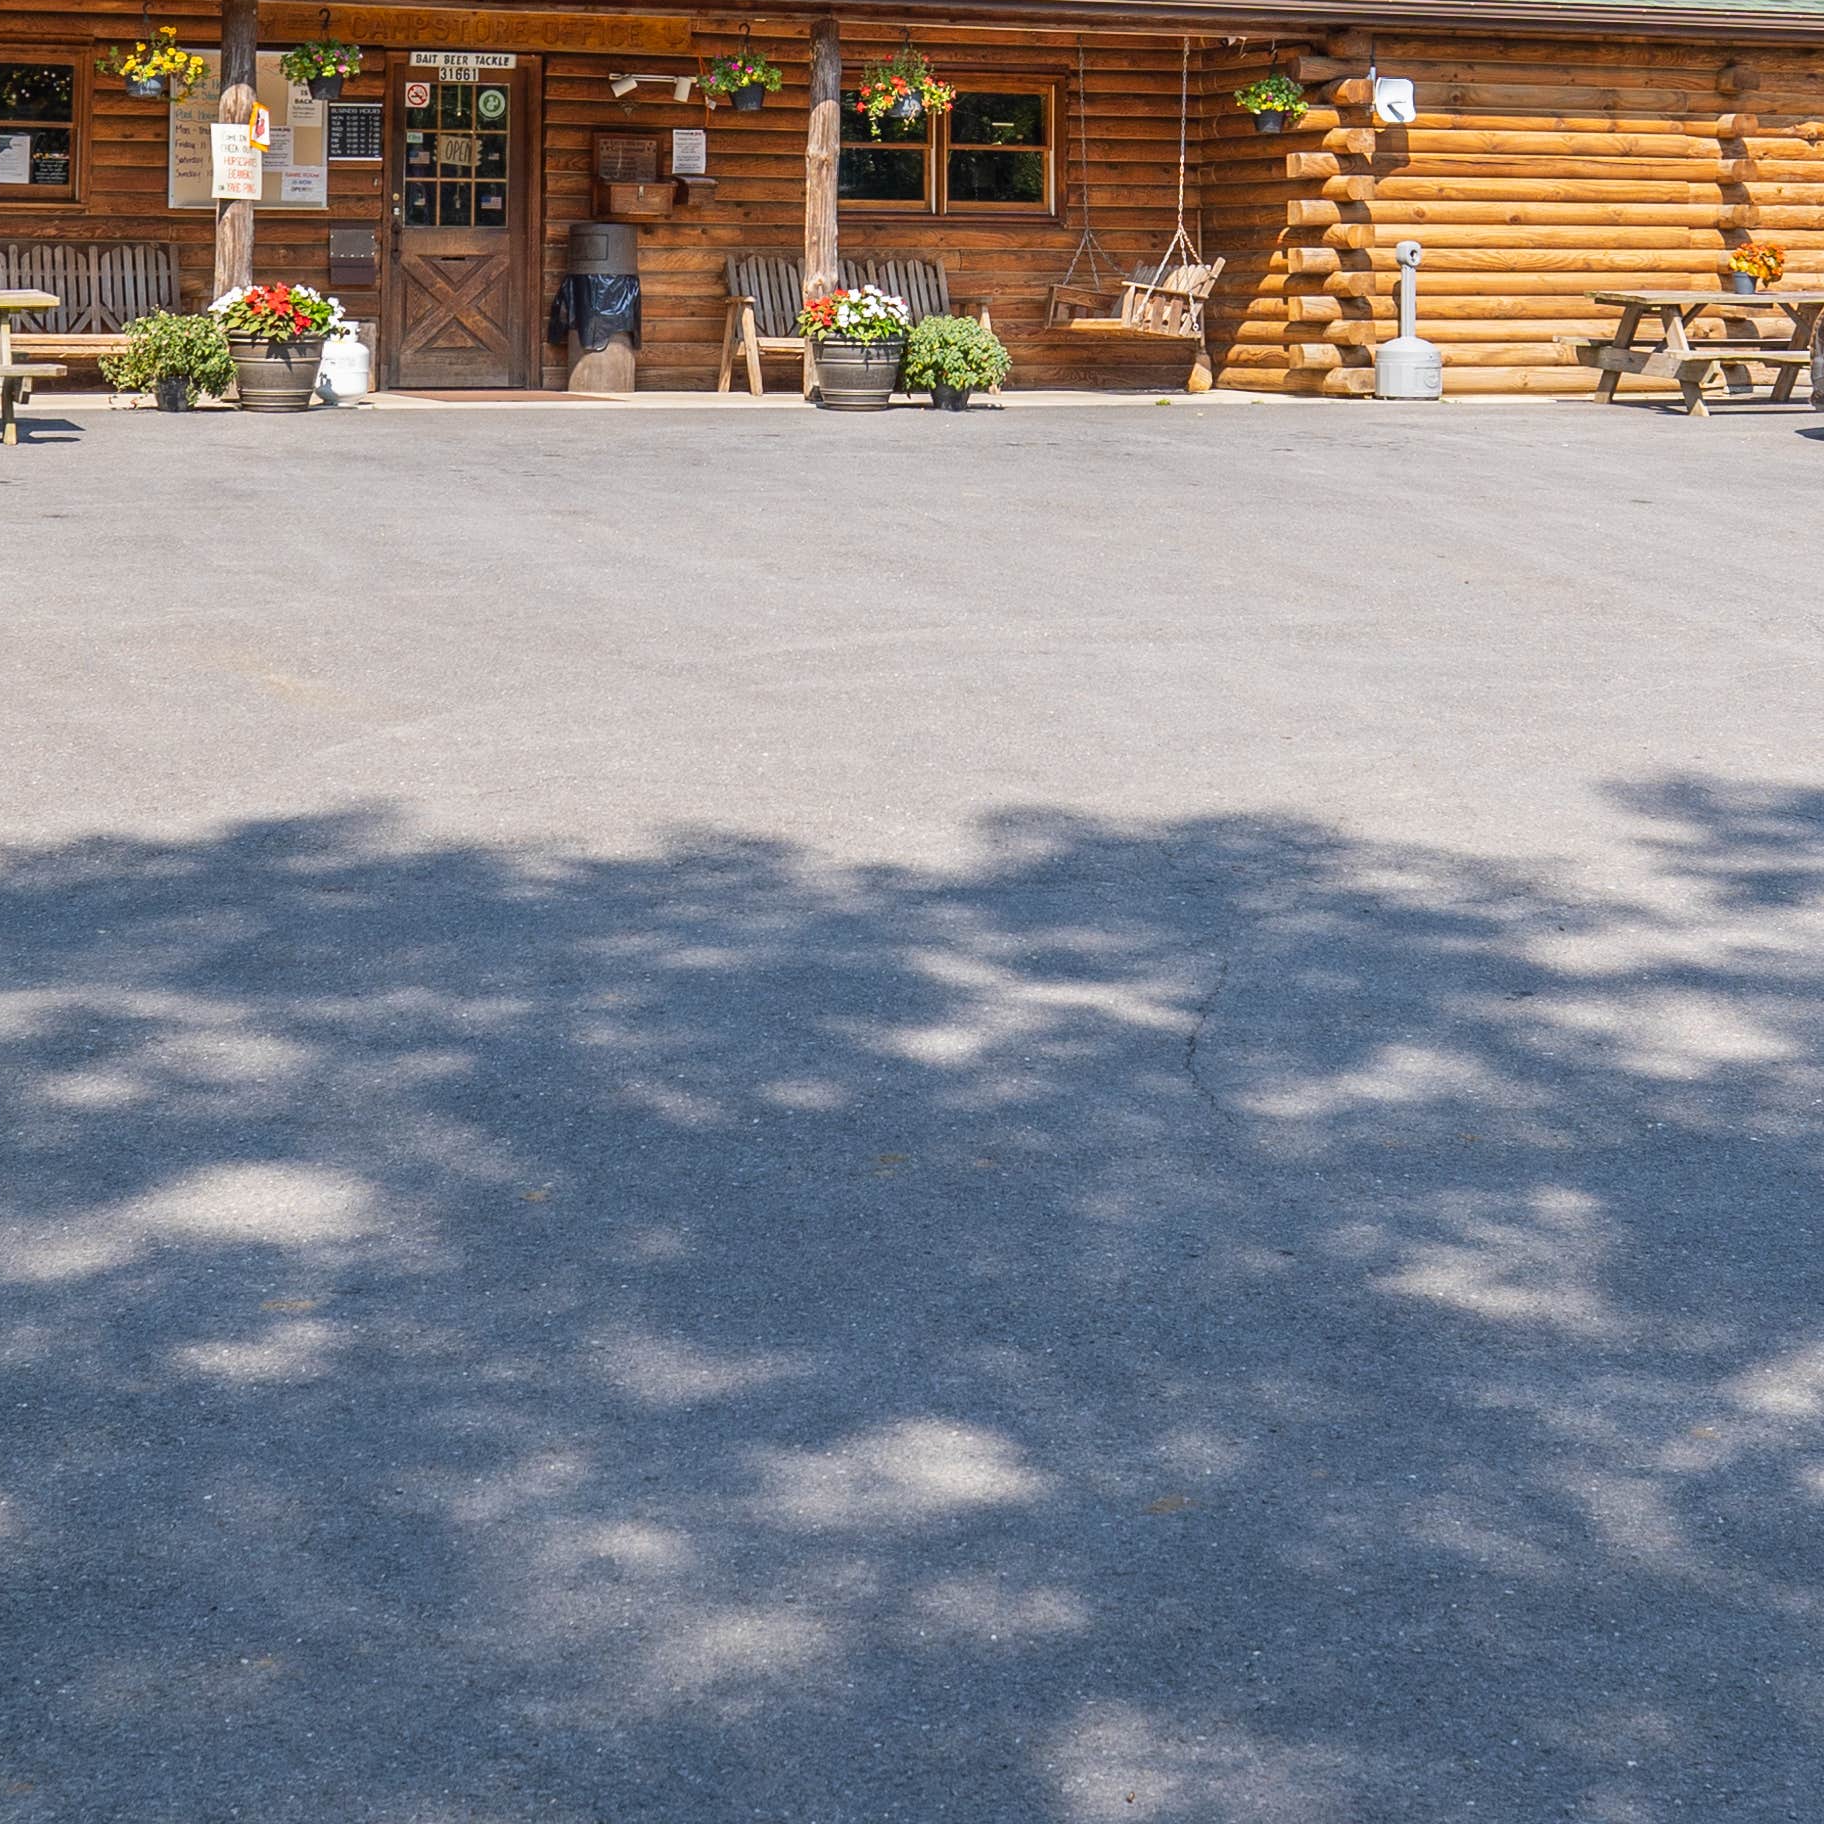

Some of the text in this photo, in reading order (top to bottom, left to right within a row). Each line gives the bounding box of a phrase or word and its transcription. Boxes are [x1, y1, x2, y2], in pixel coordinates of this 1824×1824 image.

[416, 54, 510, 66] BAIT BEER TACKLE
[440, 67, 477, 81] 31661
[445, 140, 473, 164] OPEN
